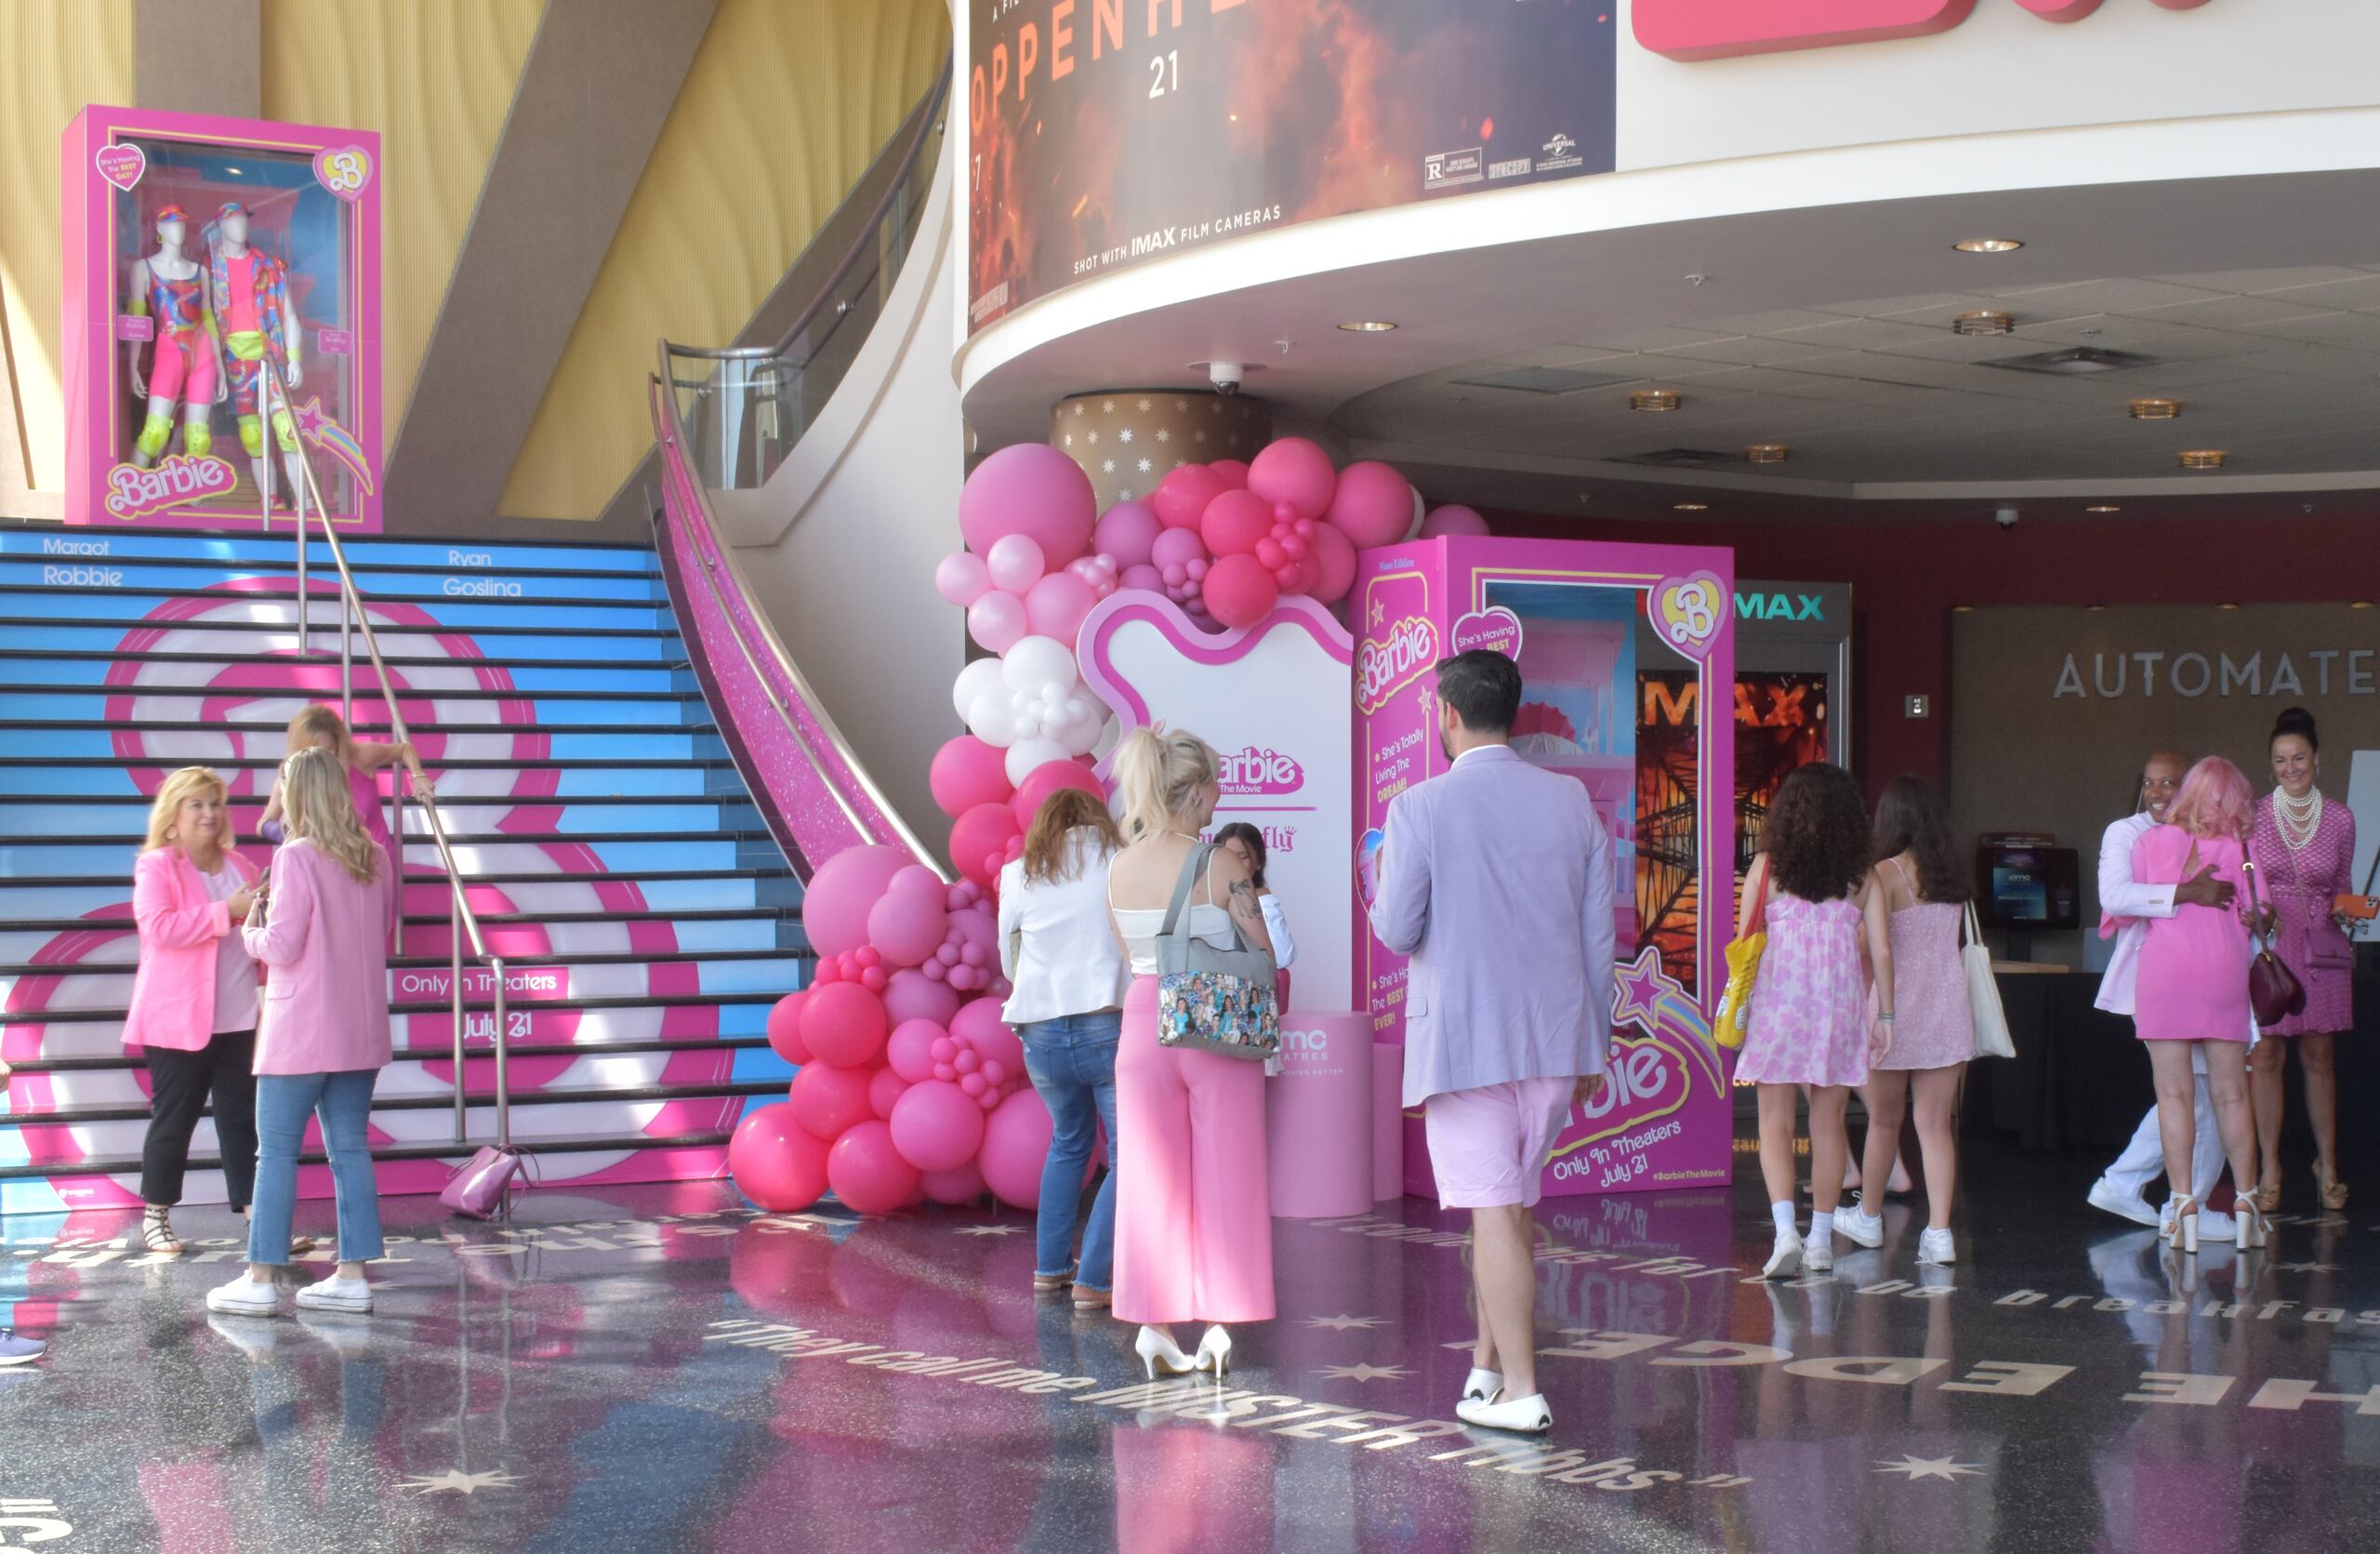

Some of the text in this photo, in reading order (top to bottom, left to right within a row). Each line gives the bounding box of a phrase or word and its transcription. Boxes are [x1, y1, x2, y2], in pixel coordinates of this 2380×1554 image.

[971, 0, 1247, 137] OPPENH
[1149, 49, 1177, 100] 21
[1542, 139, 1576, 152] UNIVERSAL
[1427, 163, 1442, 180] R
[1074, 205, 1281, 274] SHOT WITH IMAX FILM CAMERAS
[110, 458, 224, 511] Barbie
[44, 538, 110, 555] Margot
[449, 550, 491, 566] Ryan
[44, 565, 123, 586] Robbie
[443, 578, 522, 597] Gosling
[1733, 592, 1826, 621] MAX
[1458, 626, 1515, 646] She's Having
[1359, 622, 1432, 703] Barbie
[2053, 650, 2376, 698] AUTOMATE
[1382, 728, 1424, 760] She's Totally
[1219, 748, 1296, 784] arbie
[1376, 758, 1410, 784] Living The
[1221, 785, 1263, 793] The Movie
[1377, 777, 1408, 804] DREAM!
[402, 975, 449, 996] Only
[1379, 972, 1398, 990] She's
[1372, 997, 1385, 1012] The
[1386, 988, 1404, 1004] BEST
[508, 1012, 533, 1038] 21
[1280, 1029, 1328, 1051] mc
[1284, 1052, 1329, 1061] ATRES
[1554, 1121, 1681, 1180] Only In Theaters
[1601, 1153, 1648, 1188] July 21
[1653, 1169, 1726, 1181] #BarbieTheMovie
[957, 1368, 1098, 1394] me
